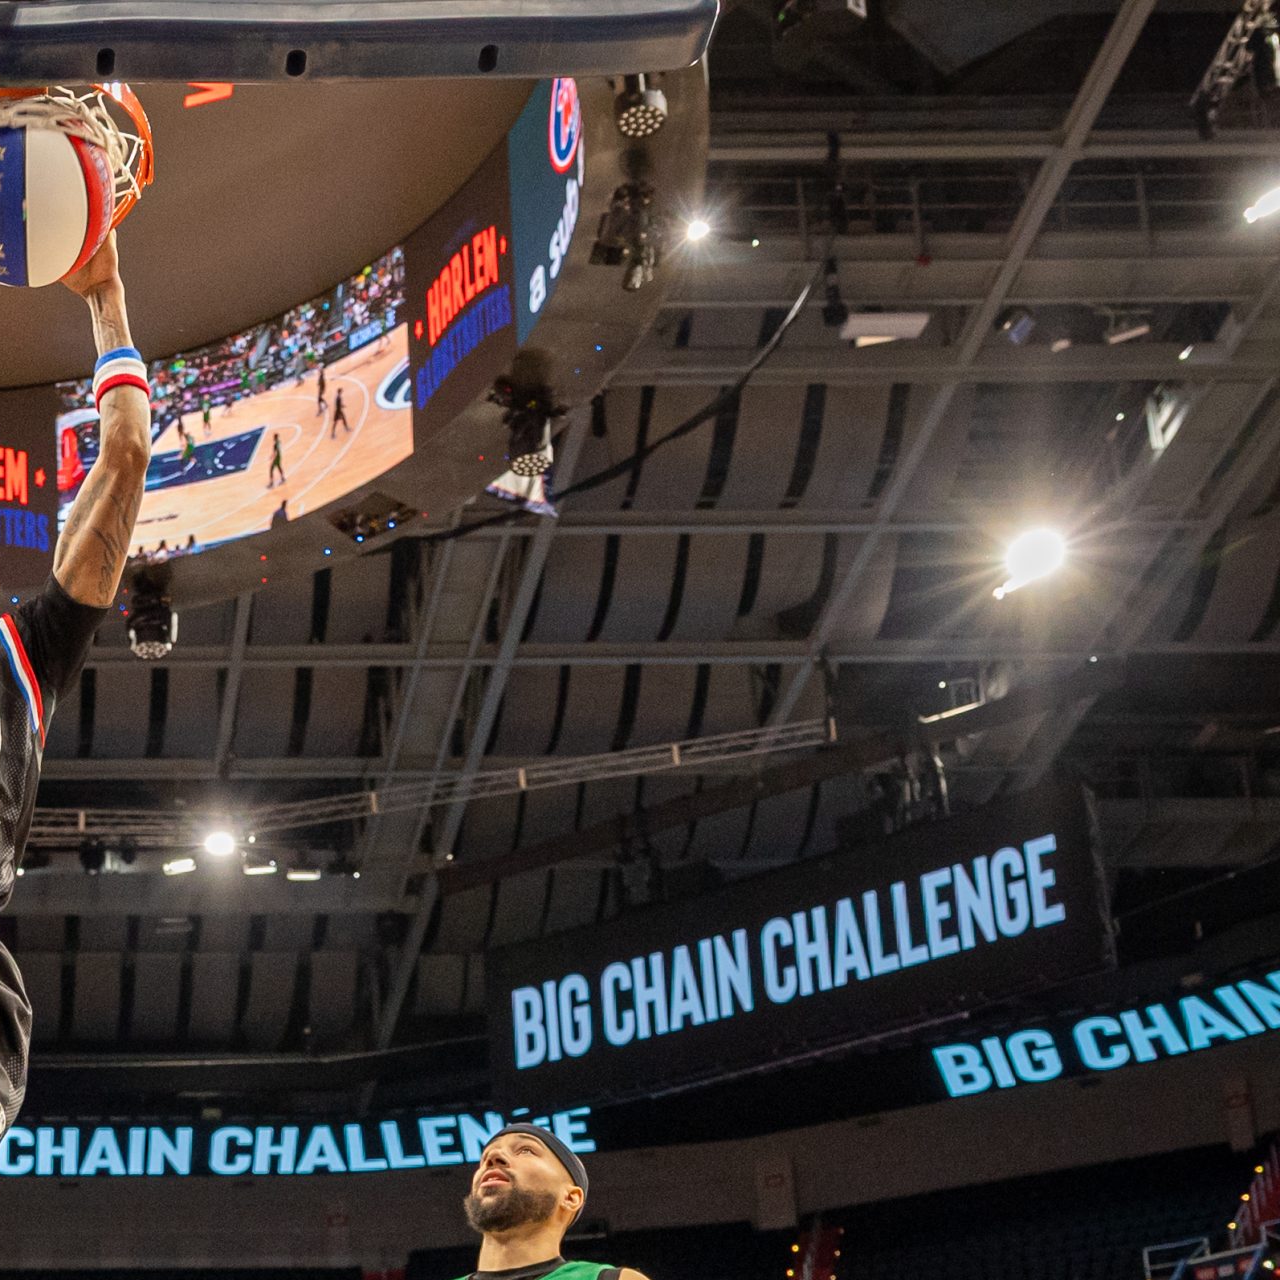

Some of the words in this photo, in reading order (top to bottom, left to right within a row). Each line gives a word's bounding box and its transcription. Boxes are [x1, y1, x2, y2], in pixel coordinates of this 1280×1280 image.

[549, 178, 580, 280] sub
[427, 224, 499, 347] HARLEM
[511, 973, 592, 1070] BIG
[601, 929, 754, 1043] CHAIN
[760, 834, 1066, 1004] CHALLENGE
[931, 1028, 1064, 1098] BIG
[209, 1106, 597, 1175] CHALLENE
